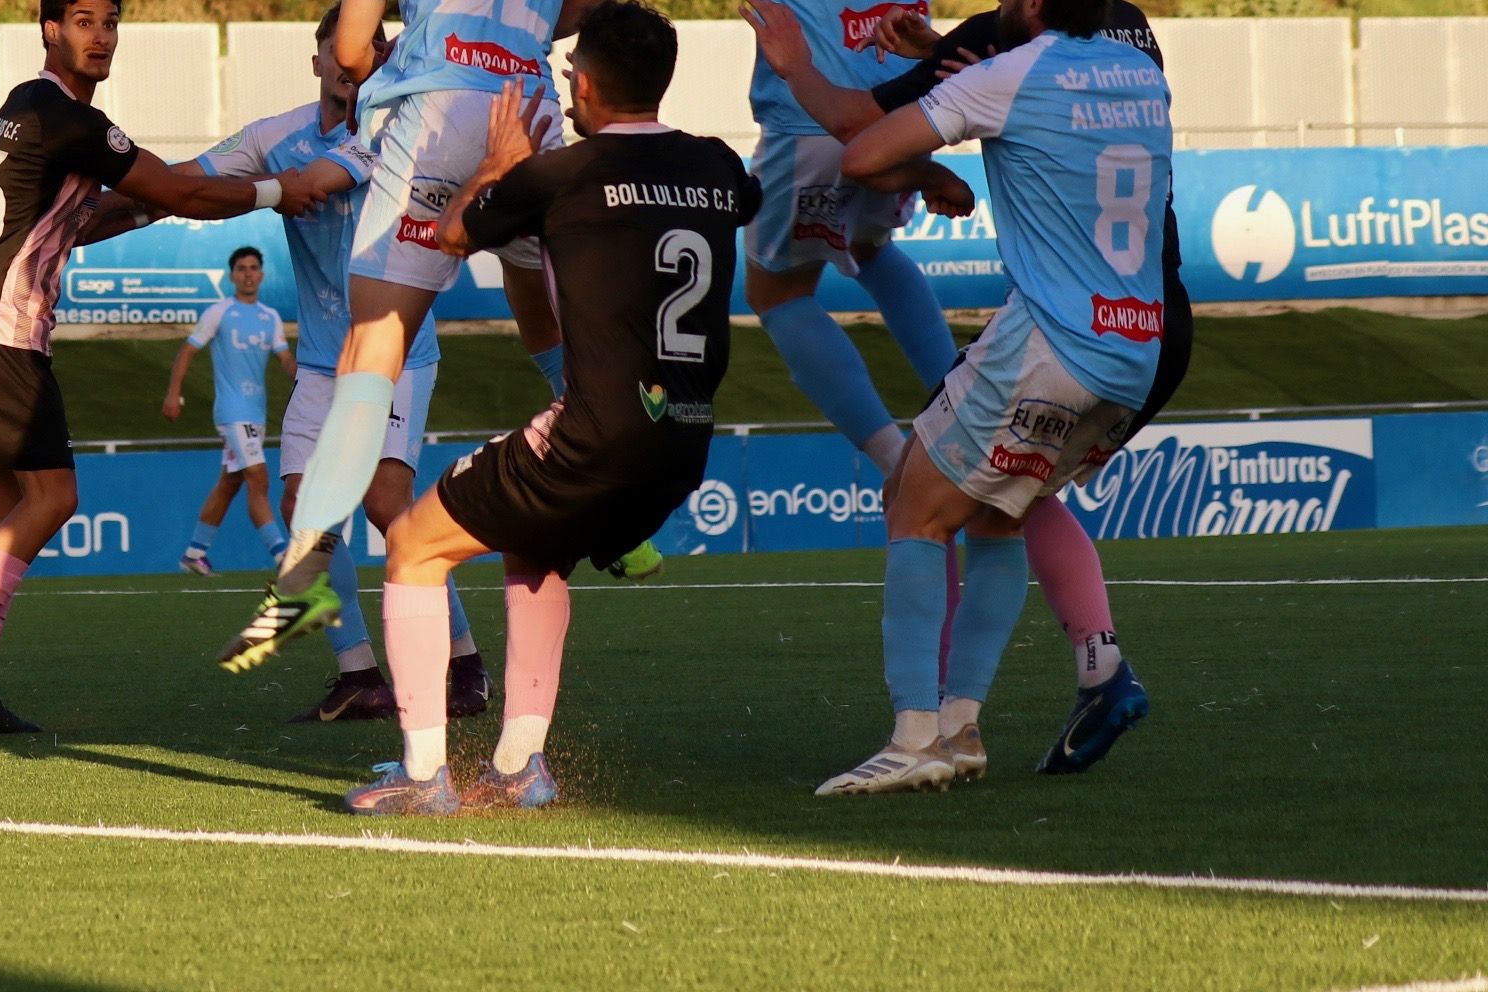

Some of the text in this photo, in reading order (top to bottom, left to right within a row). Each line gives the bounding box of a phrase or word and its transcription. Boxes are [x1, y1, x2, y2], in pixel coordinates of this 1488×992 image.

[1071, 98, 1166, 130] ALBERTO
[604, 182, 710, 209] BOLLULLOS
[1094, 143, 1153, 276] 8
[925, 259, 1005, 277] CONSTRUC
[77, 278, 116, 294] sage
[654, 228, 713, 364] 2
[1211, 447, 1332, 486] Pinturas
